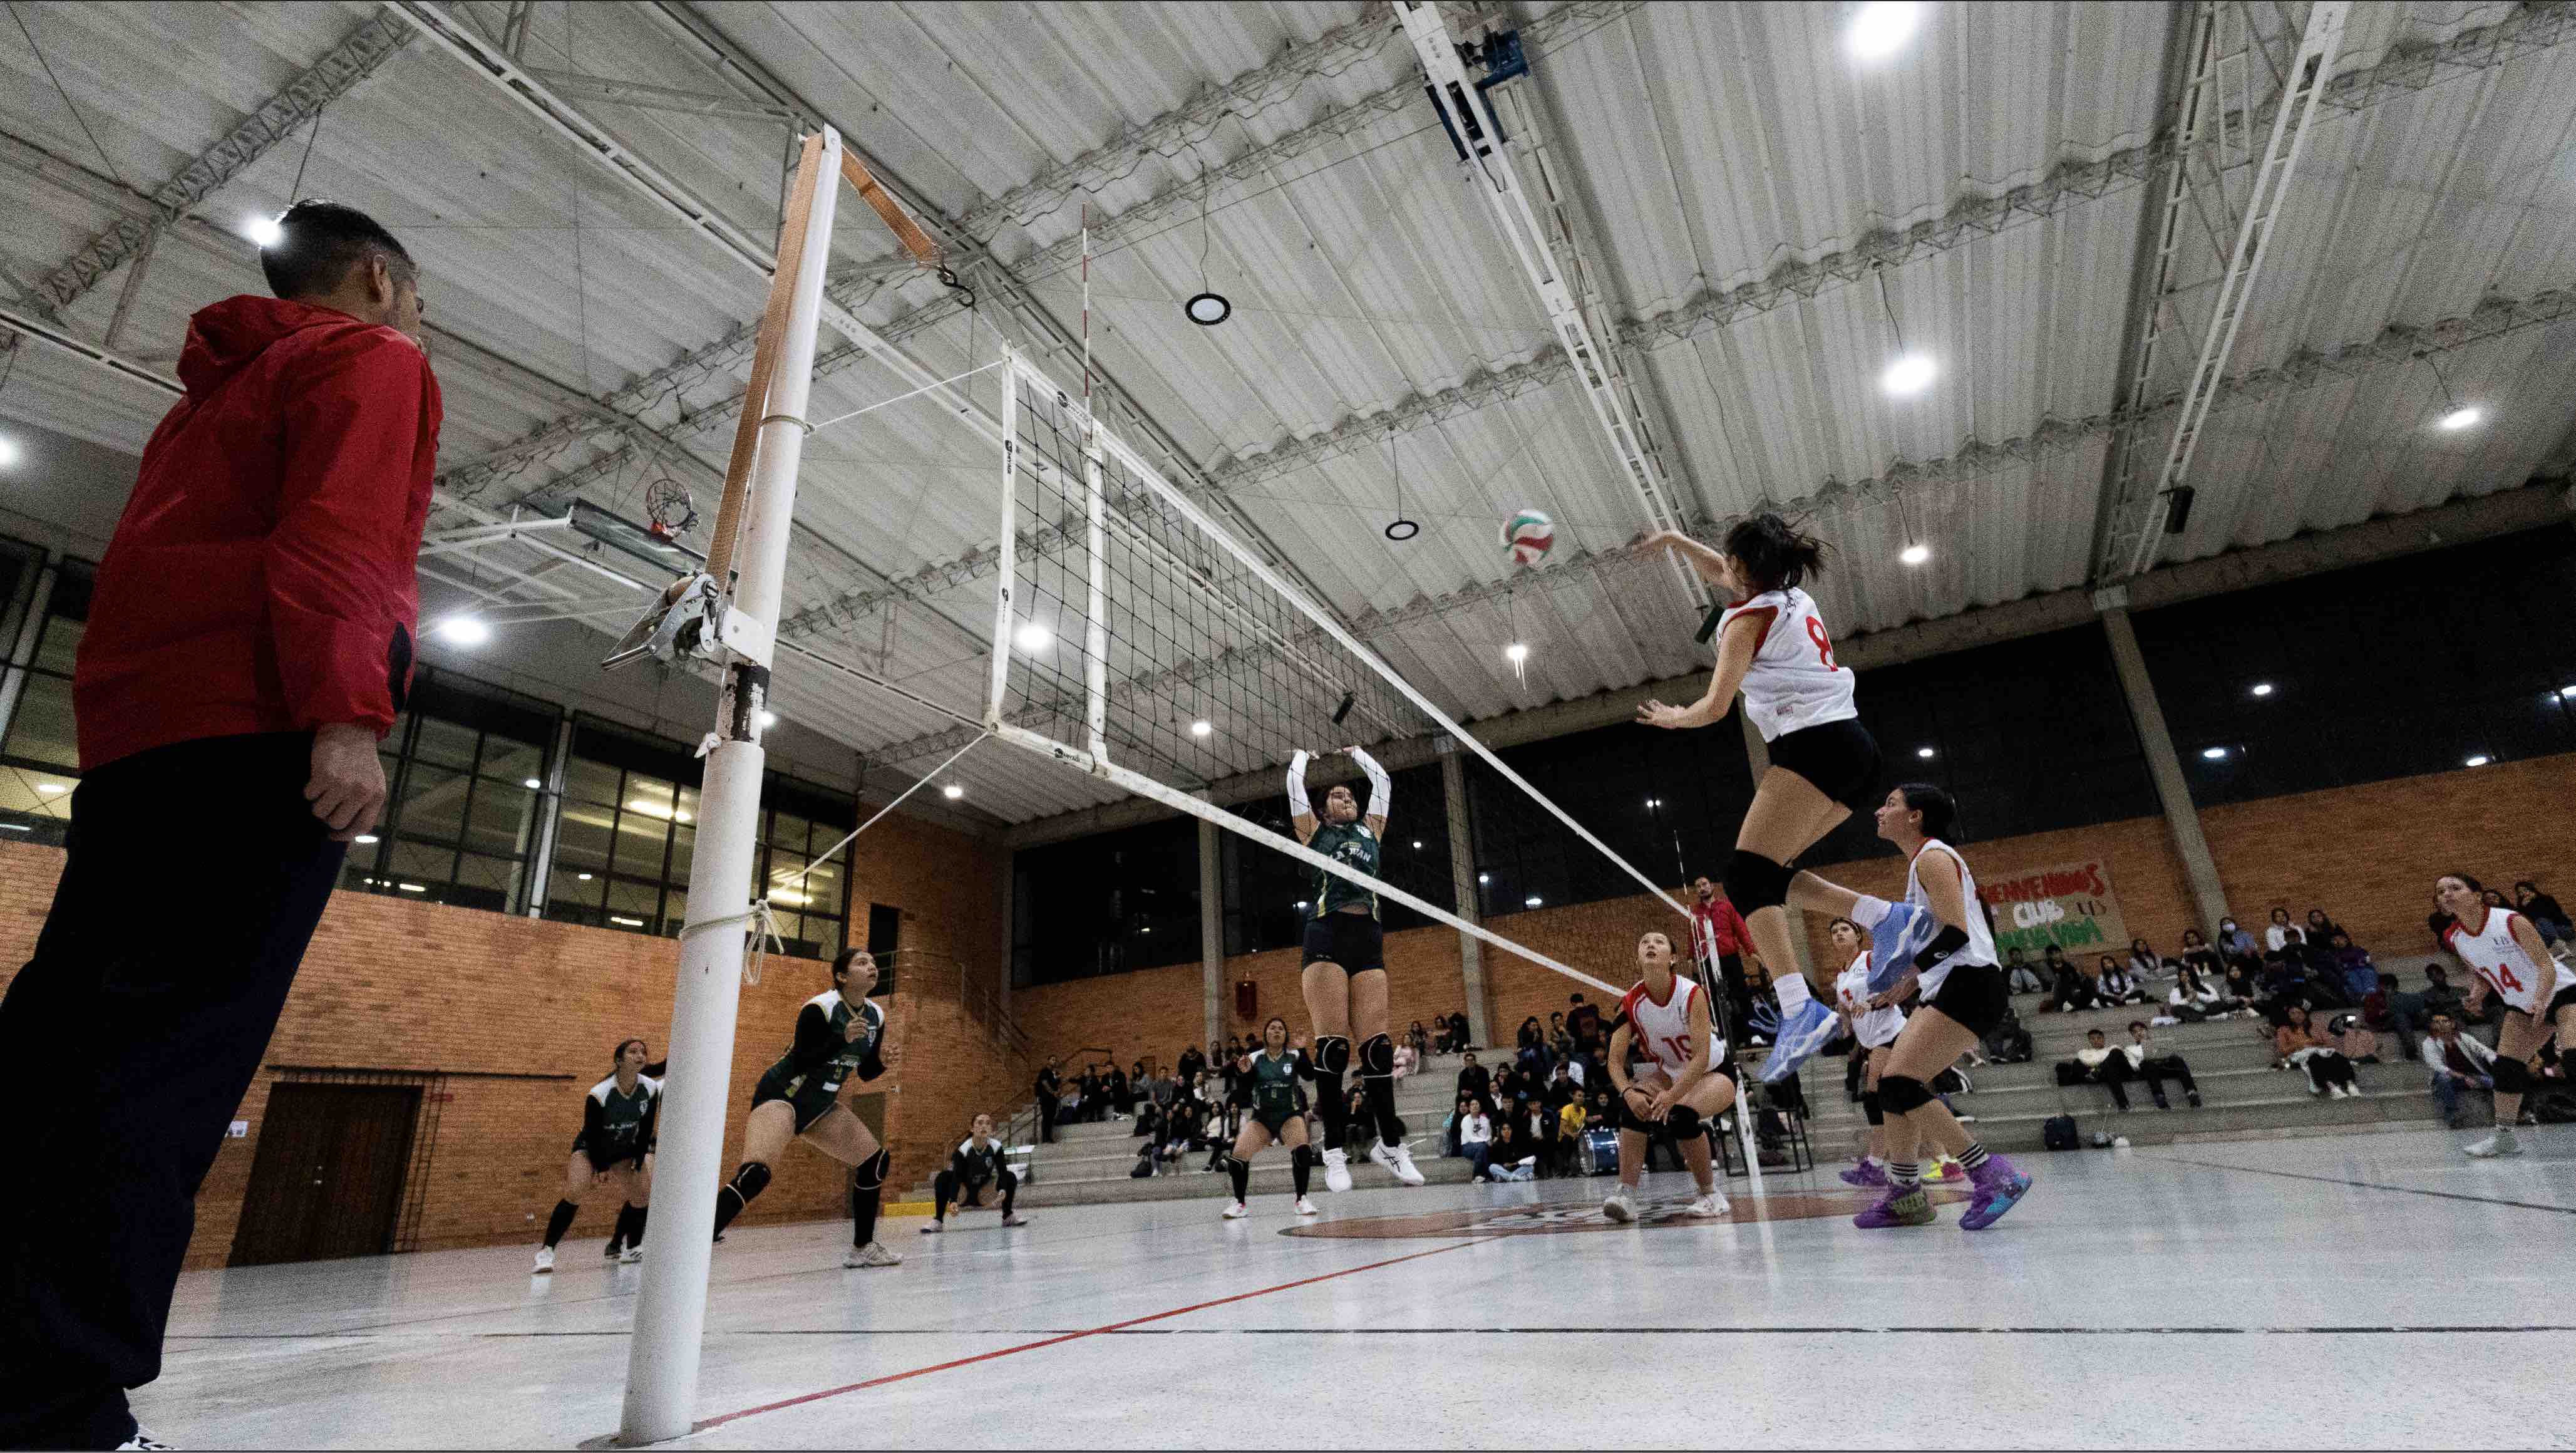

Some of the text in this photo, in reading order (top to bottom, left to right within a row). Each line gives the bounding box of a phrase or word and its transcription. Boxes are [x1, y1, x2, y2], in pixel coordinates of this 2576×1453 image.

[1805, 615, 1838, 672] 8
[2013, 899, 2064, 928] CLUB
[2480, 964, 2524, 995] 14
